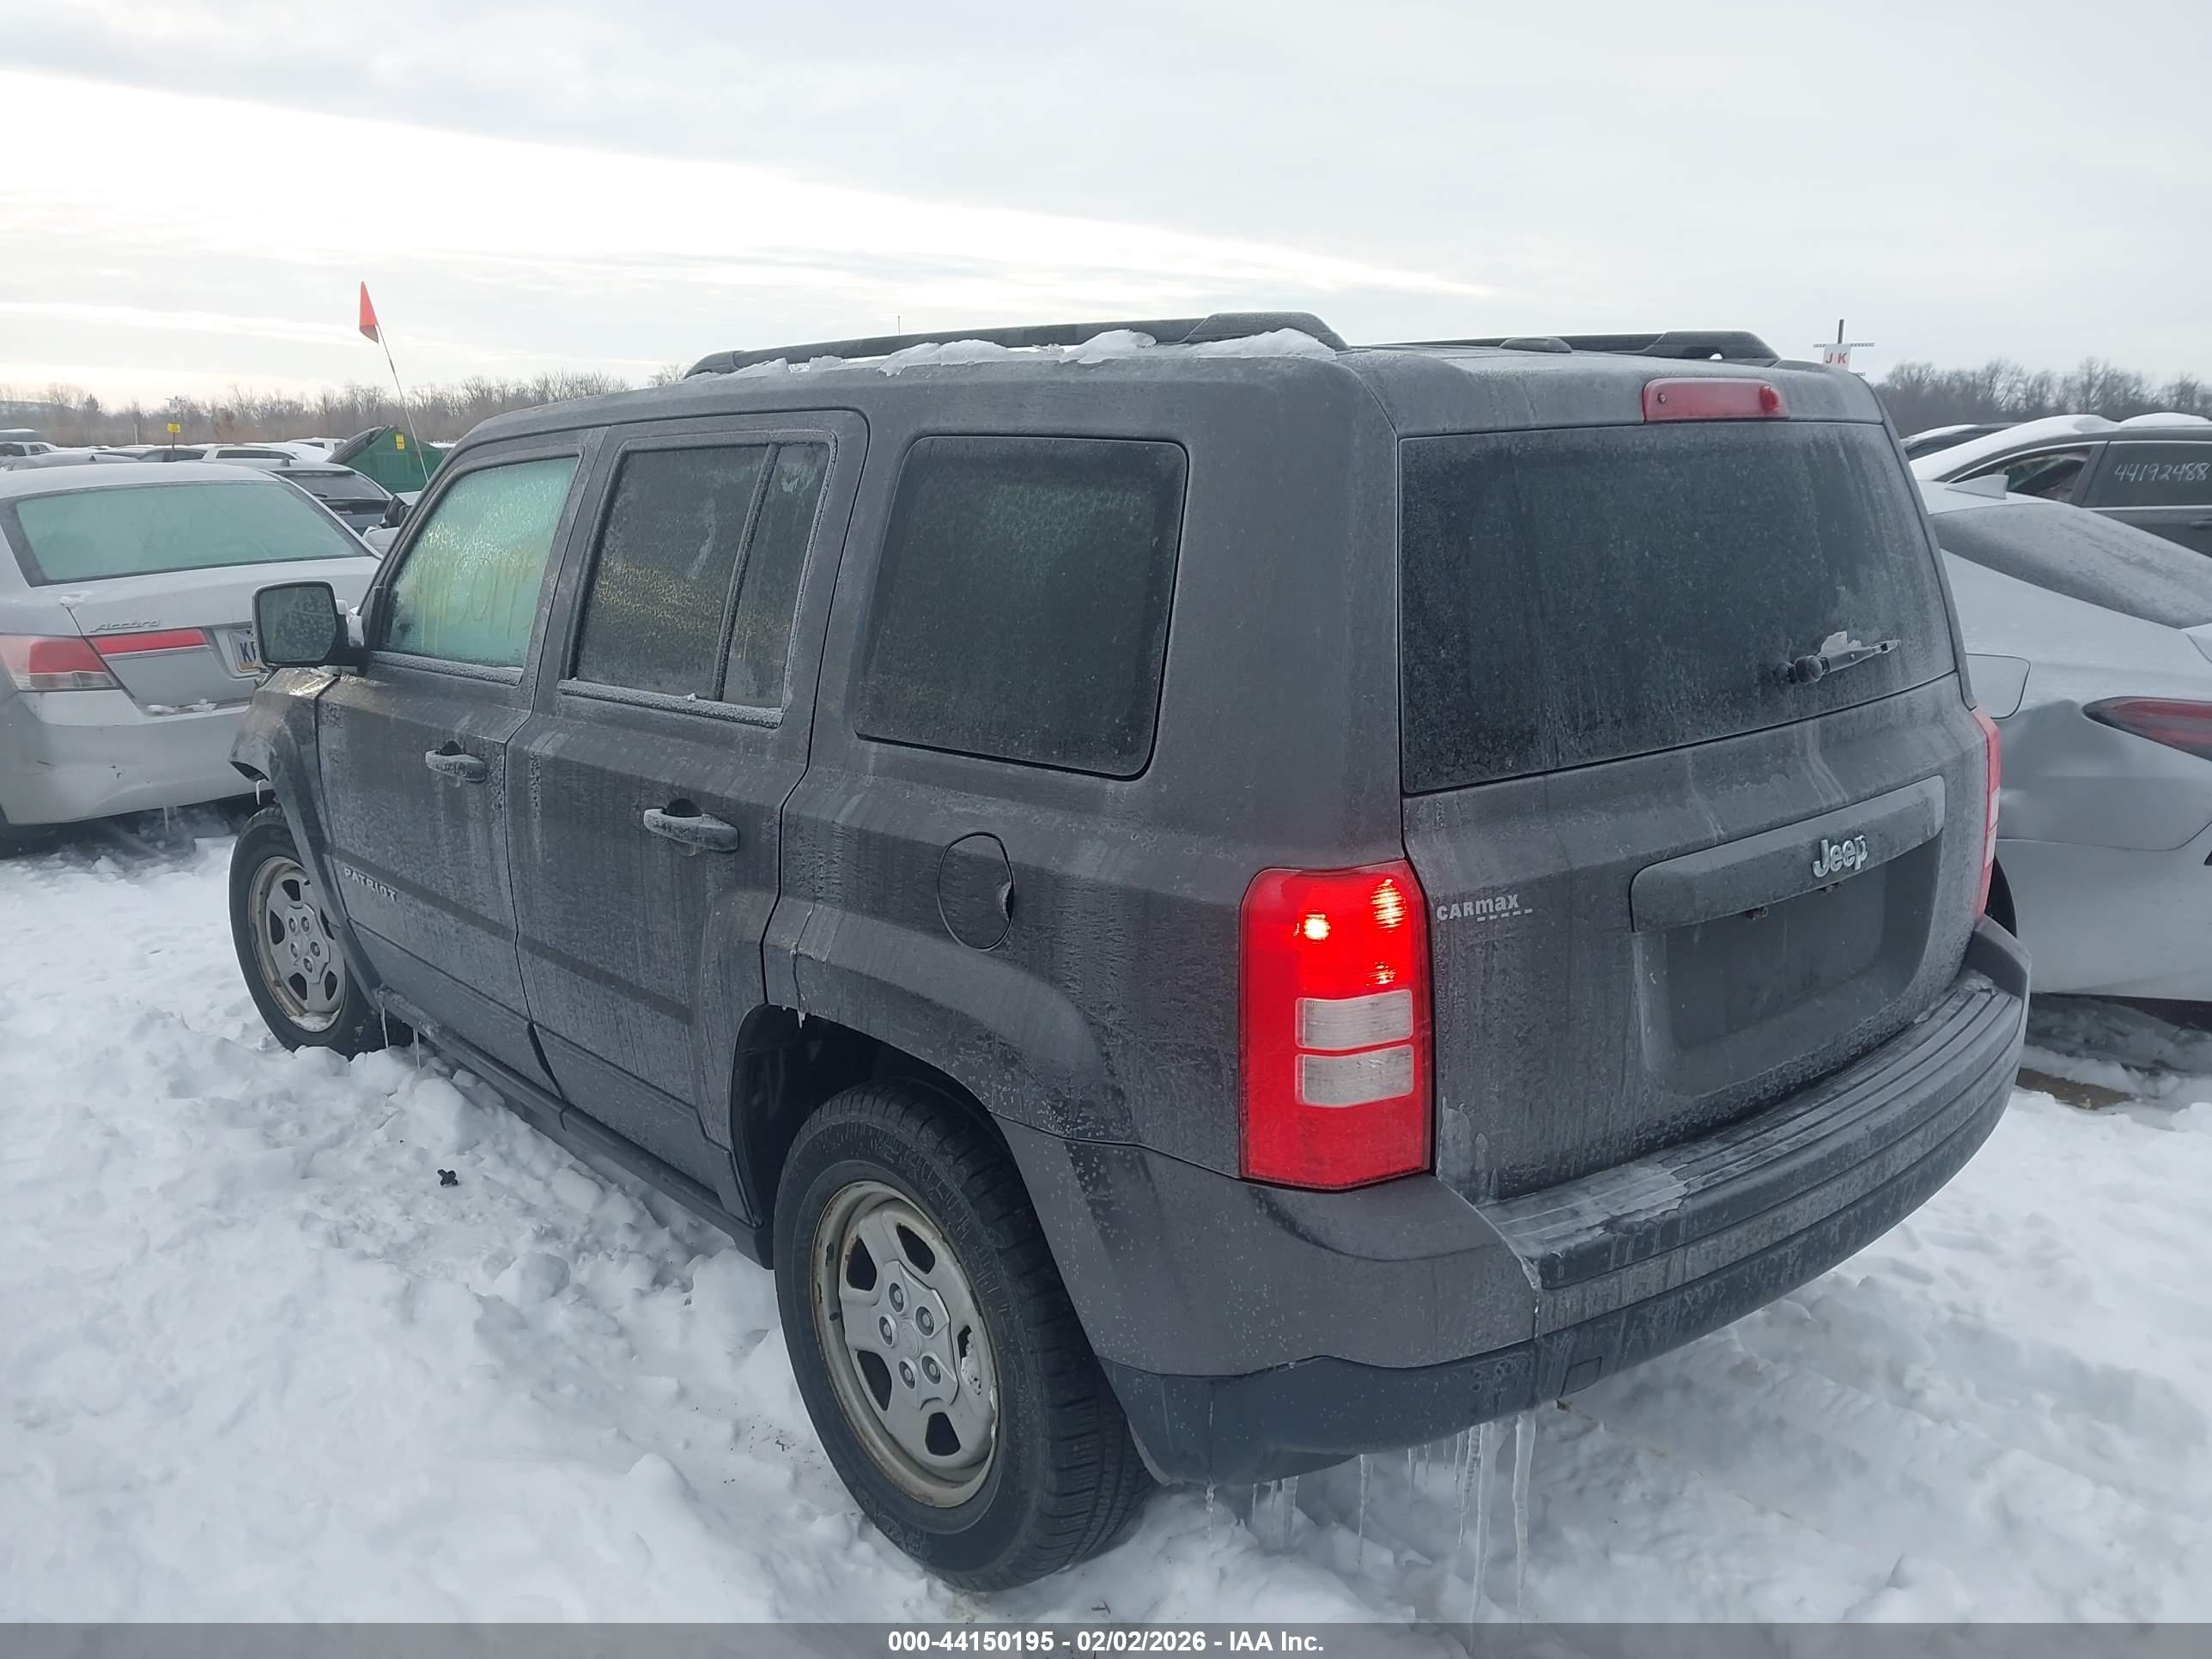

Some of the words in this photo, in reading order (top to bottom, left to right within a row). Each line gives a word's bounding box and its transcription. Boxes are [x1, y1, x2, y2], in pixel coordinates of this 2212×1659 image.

[2114, 463, 2211, 482] 44192488
[1813, 835, 1868, 878] Jeep
[343, 866, 397, 902] PATRIOT
